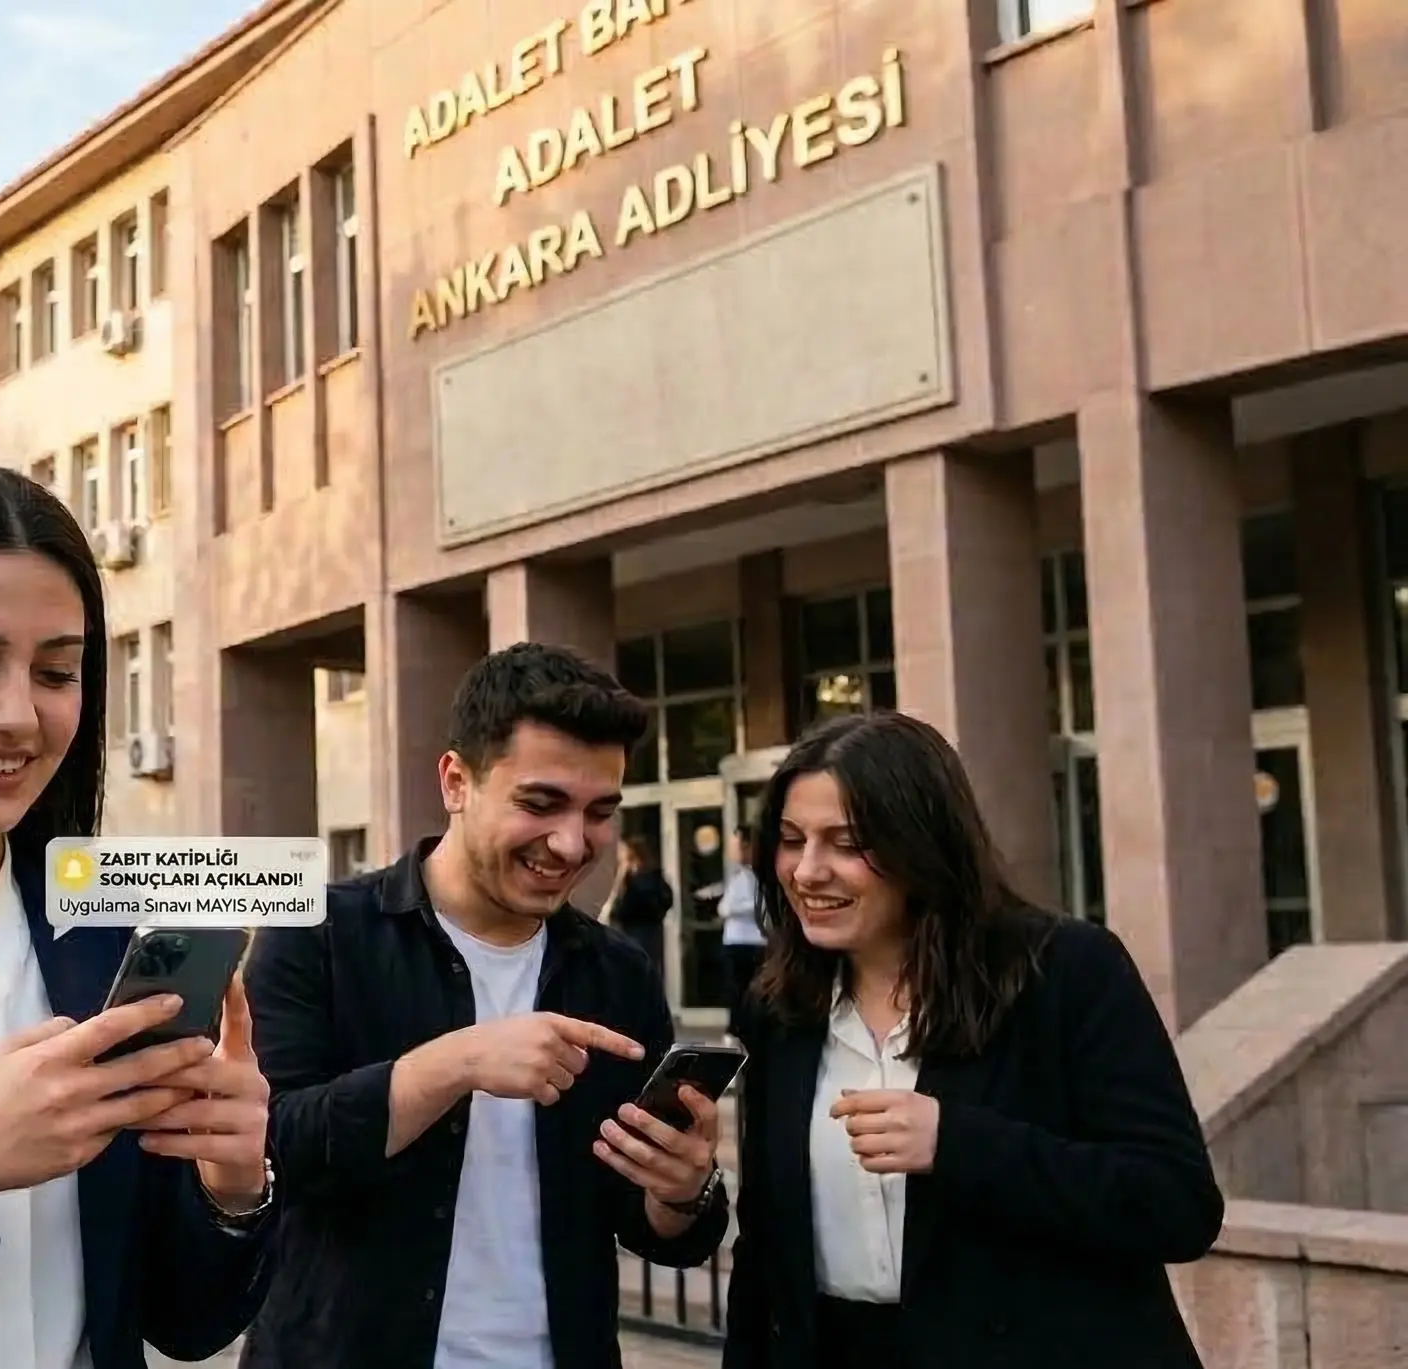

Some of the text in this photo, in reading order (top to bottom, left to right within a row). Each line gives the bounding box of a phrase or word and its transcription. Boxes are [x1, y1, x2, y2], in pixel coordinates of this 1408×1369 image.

[404, 19, 568, 157] ADALET
[494, 47, 708, 206] ADALET
[409, 47, 906, 338] ANKARA ADLİYESİ
